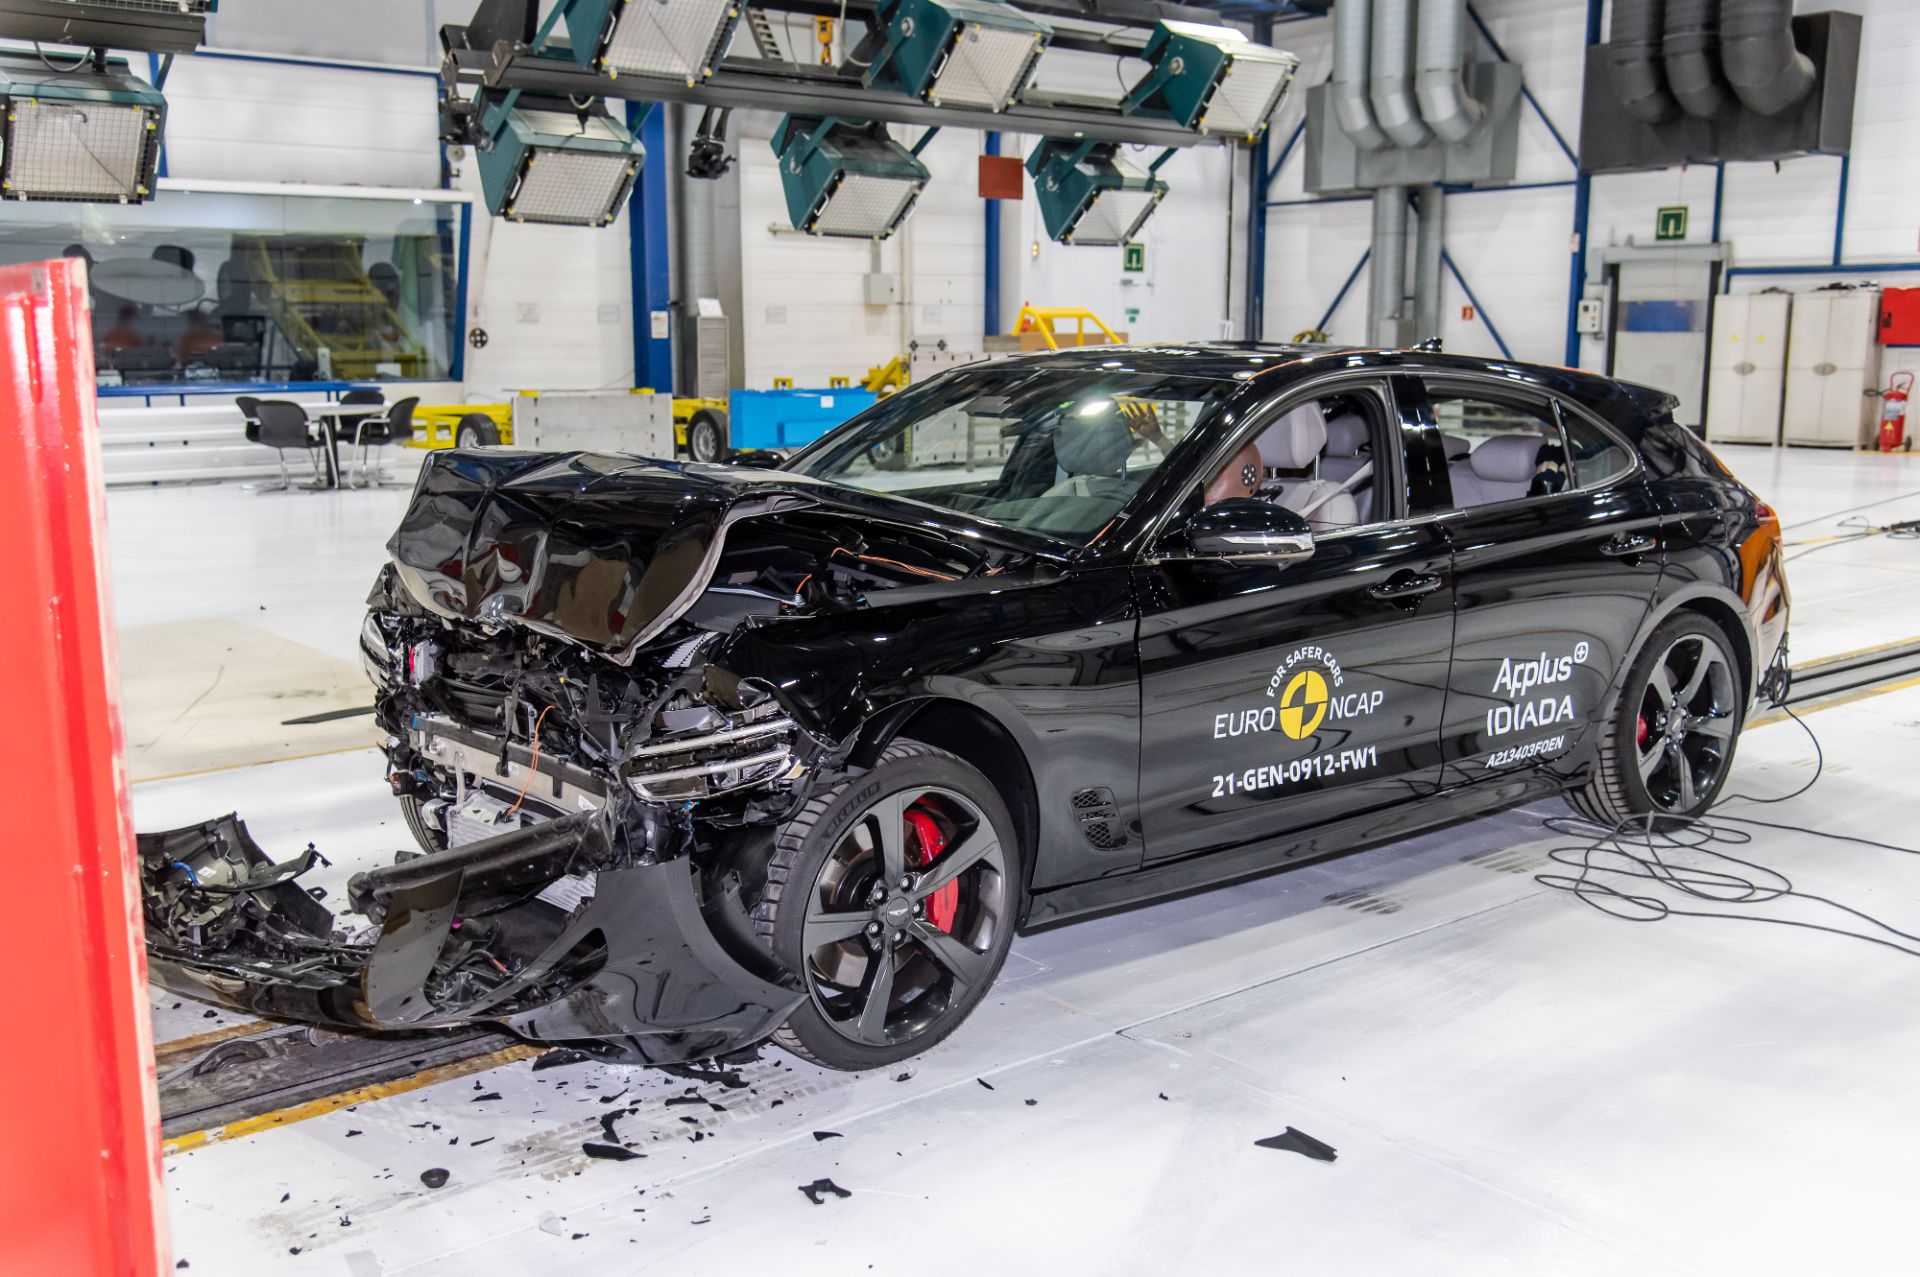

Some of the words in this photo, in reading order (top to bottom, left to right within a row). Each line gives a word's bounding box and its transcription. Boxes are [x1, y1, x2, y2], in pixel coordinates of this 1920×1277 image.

[1266, 665, 1287, 697] FOR
[1285, 646, 1323, 668] SAFER
[1323, 652, 1344, 688] CARS
[1214, 706, 1276, 739] EURO
[1329, 690, 1383, 721] NCAP
[1487, 695, 1574, 736] IDIADA
[1212, 745, 1377, 798] 21-GEN-0912-FW1
